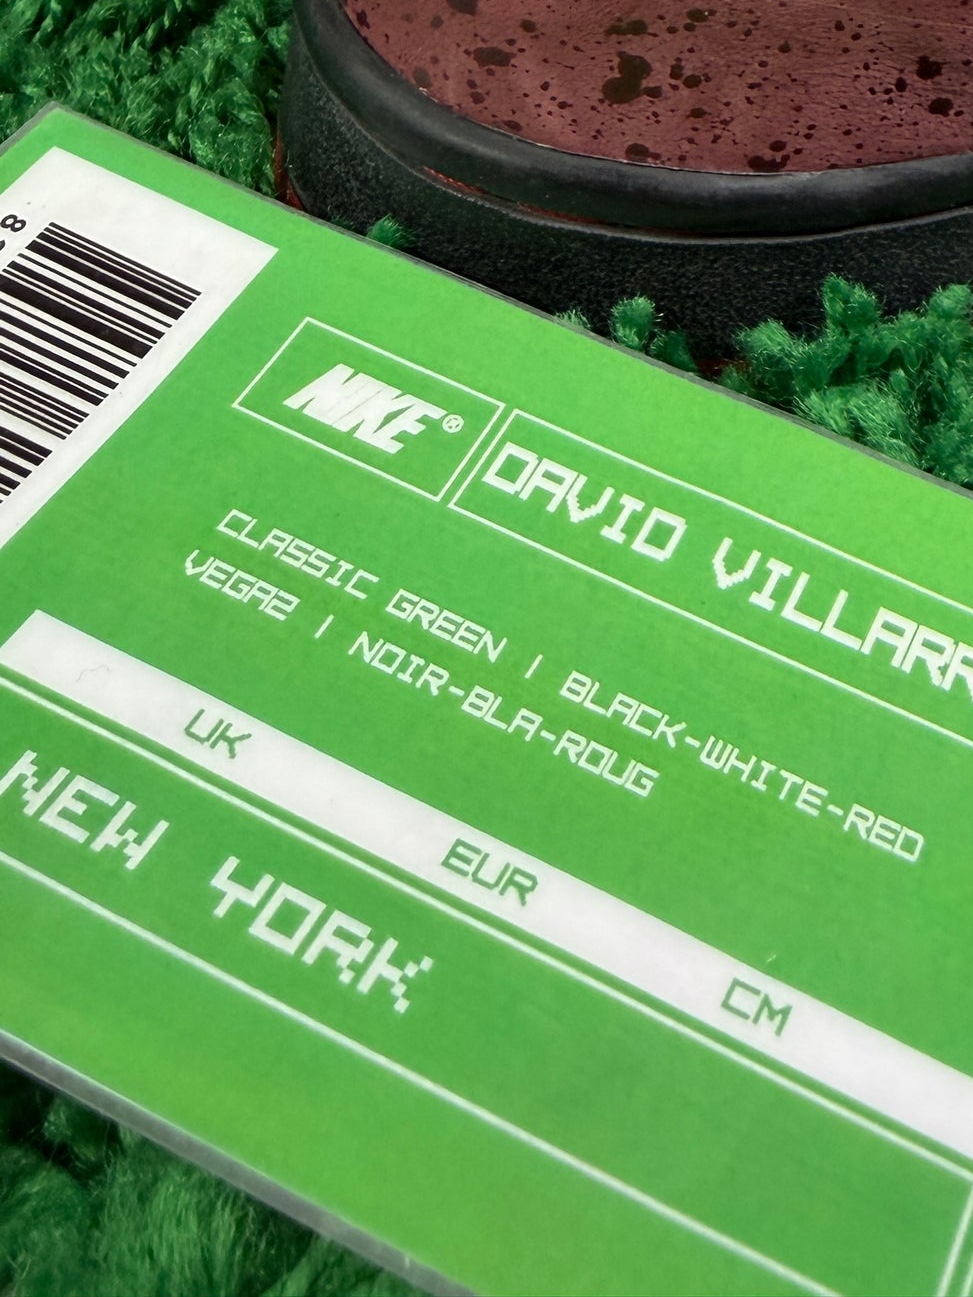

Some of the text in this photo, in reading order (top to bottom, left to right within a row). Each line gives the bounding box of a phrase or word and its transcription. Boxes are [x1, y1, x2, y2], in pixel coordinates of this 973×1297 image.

[480, 440, 688, 565] DAVID
[215, 508, 381, 600] CLASSIC
[384, 588, 508, 664] GREEN
[558, 670, 926, 865] BLACK-WHITE-RED
[348, 630, 661, 800] NOIR-BLA-ROUG
[0, 749, 435, 1015] NEW YORK
[184, 708, 794, 1038] UK EUR CM
